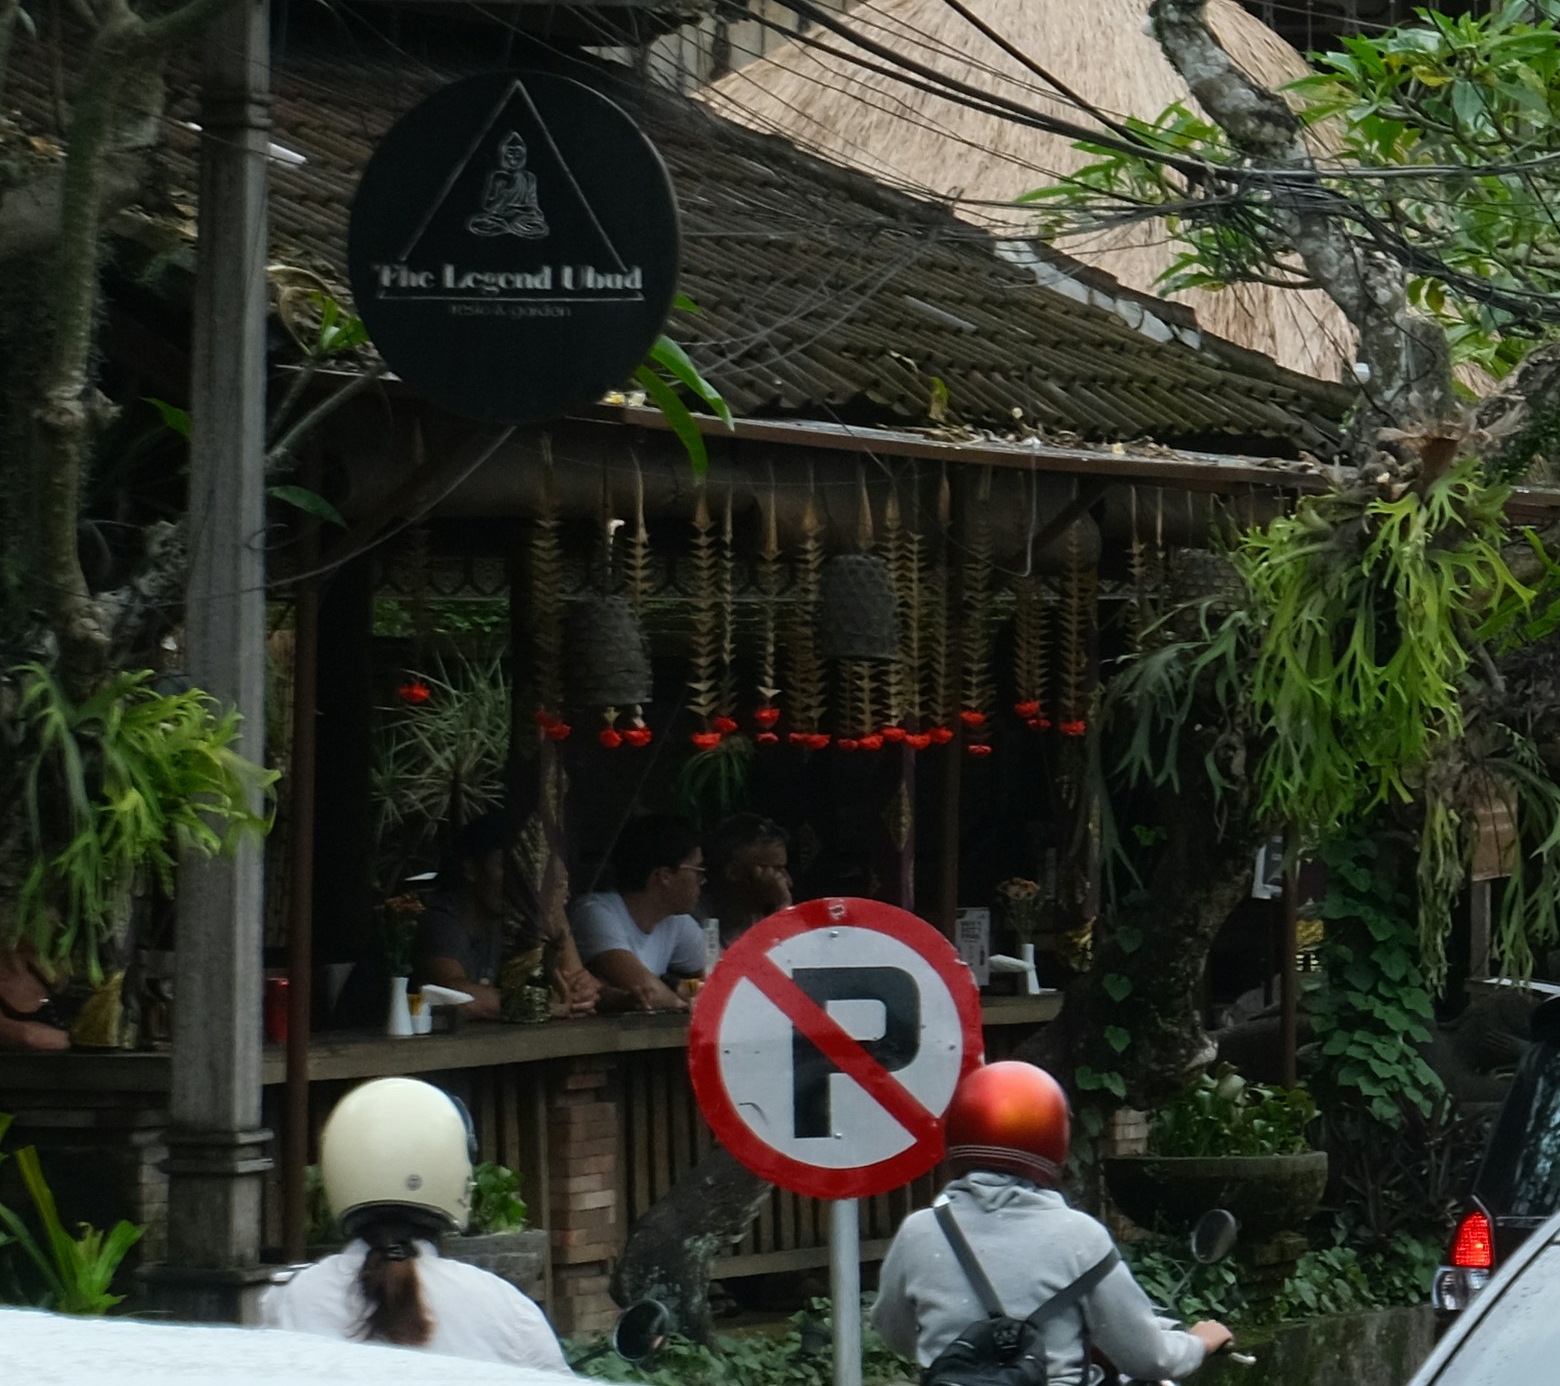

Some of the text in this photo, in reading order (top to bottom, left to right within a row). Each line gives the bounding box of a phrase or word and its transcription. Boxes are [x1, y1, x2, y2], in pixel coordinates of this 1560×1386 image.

[375, 263, 643, 295] The Legend Ubud
[790, 965, 922, 1140] P
